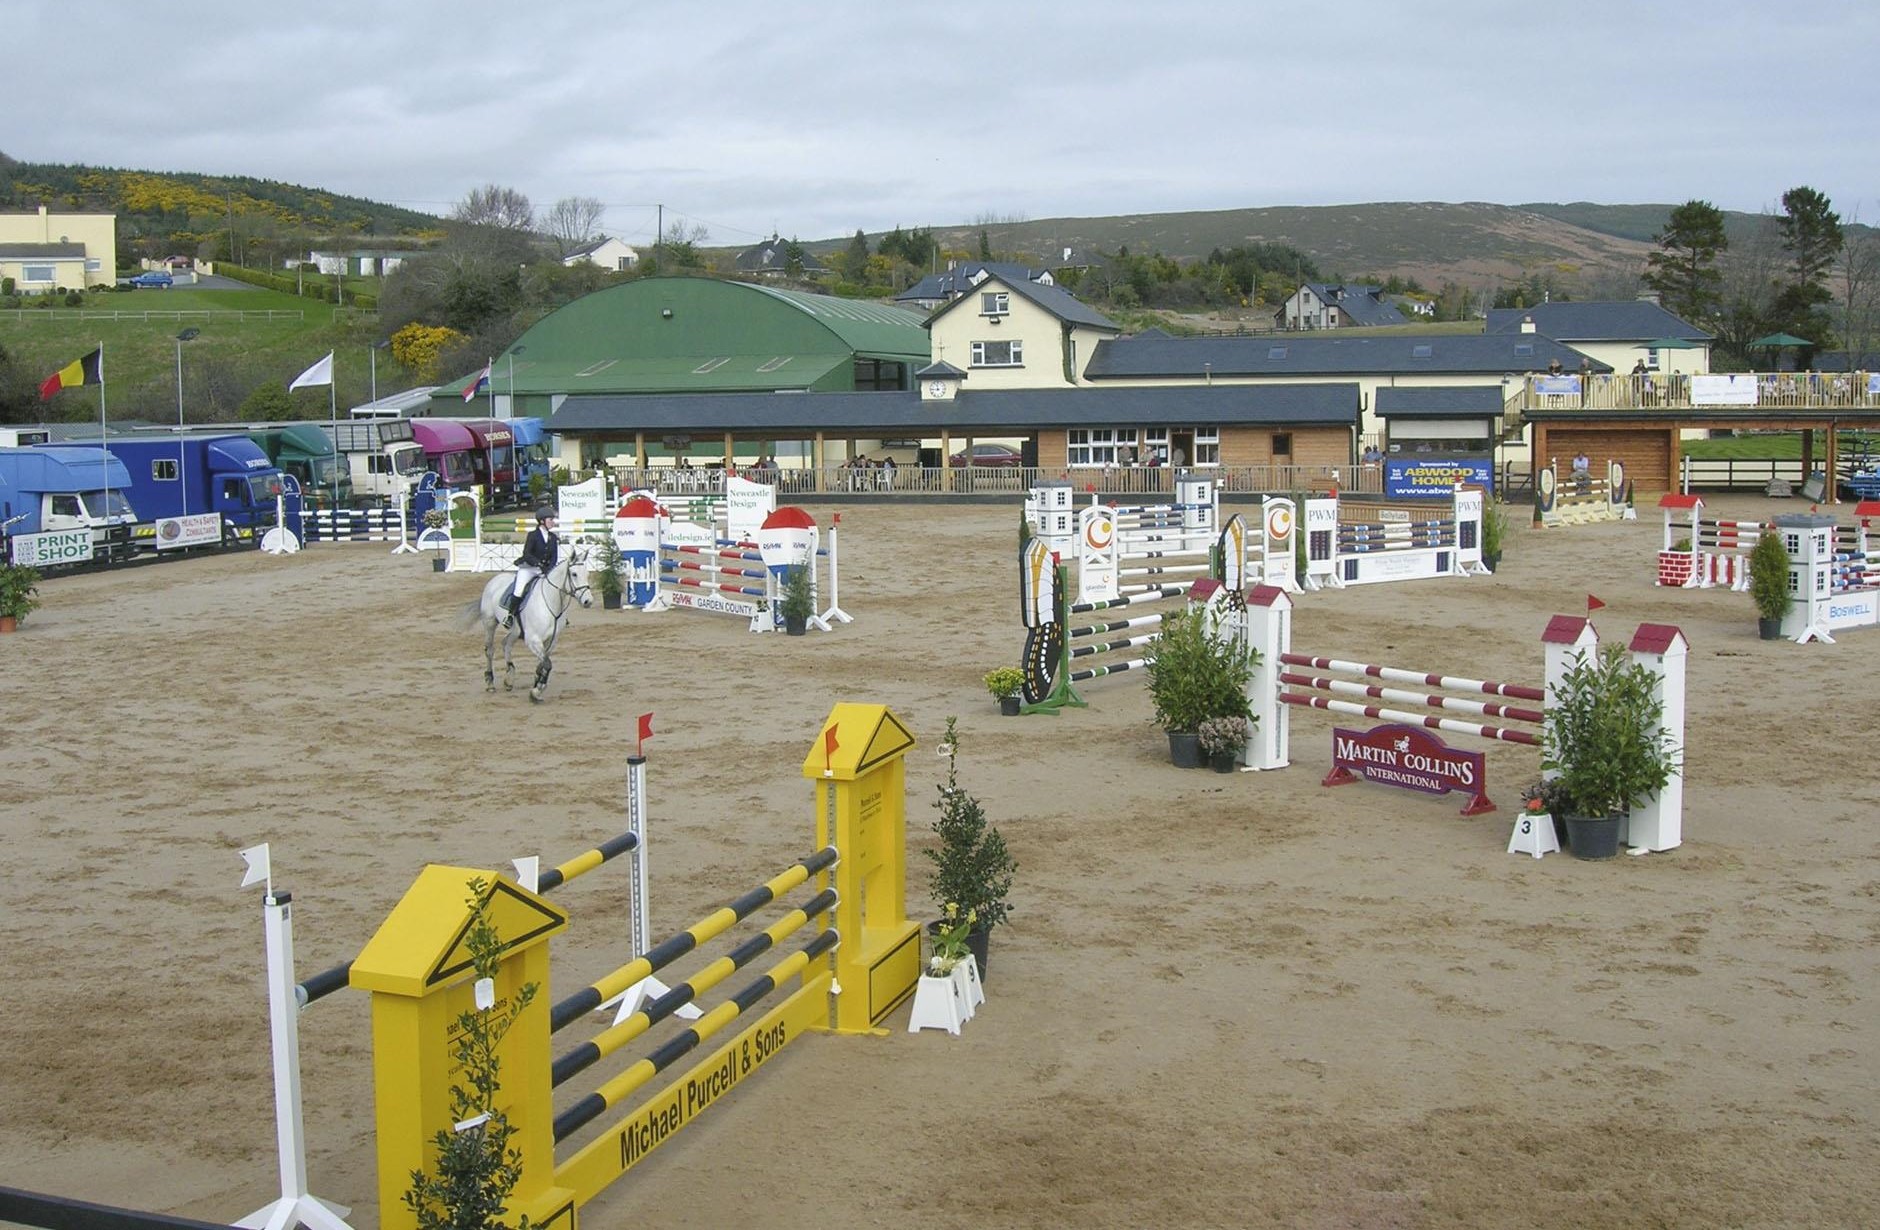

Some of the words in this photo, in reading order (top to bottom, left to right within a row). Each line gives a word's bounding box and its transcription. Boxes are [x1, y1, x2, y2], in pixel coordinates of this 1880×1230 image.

[1405, 468, 1474, 476] ABWOOD
[561, 490, 599, 498] Newcastle
[730, 489, 769, 497] Newcastle
[561, 500, 586, 508] Design
[730, 500, 757, 508] Design
[1458, 501, 1481, 512] PWM
[1309, 509, 1335, 521] PWM
[38, 533, 89, 547] PRINT
[38, 545, 90, 560] SHOP
[697, 598, 724, 611] GARDEN
[725, 602, 752, 614] COUNTY
[1830, 604, 1871, 618] BOSWELL
[1336, 737, 1397, 766] MARTIN
[1404, 754, 1474, 785] COLLINS
[1366, 766, 1441, 790] INTERNATIONAL
[1521, 821, 1531, 834] 3
[969, 964, 975, 982] 9
[953, 981, 959, 998] 4
[620, 1090, 683, 1169] Michael
[687, 1048, 737, 1117] Purcell
[741, 1039, 751, 1074] &
[755, 1021, 785, 1063] Sons
